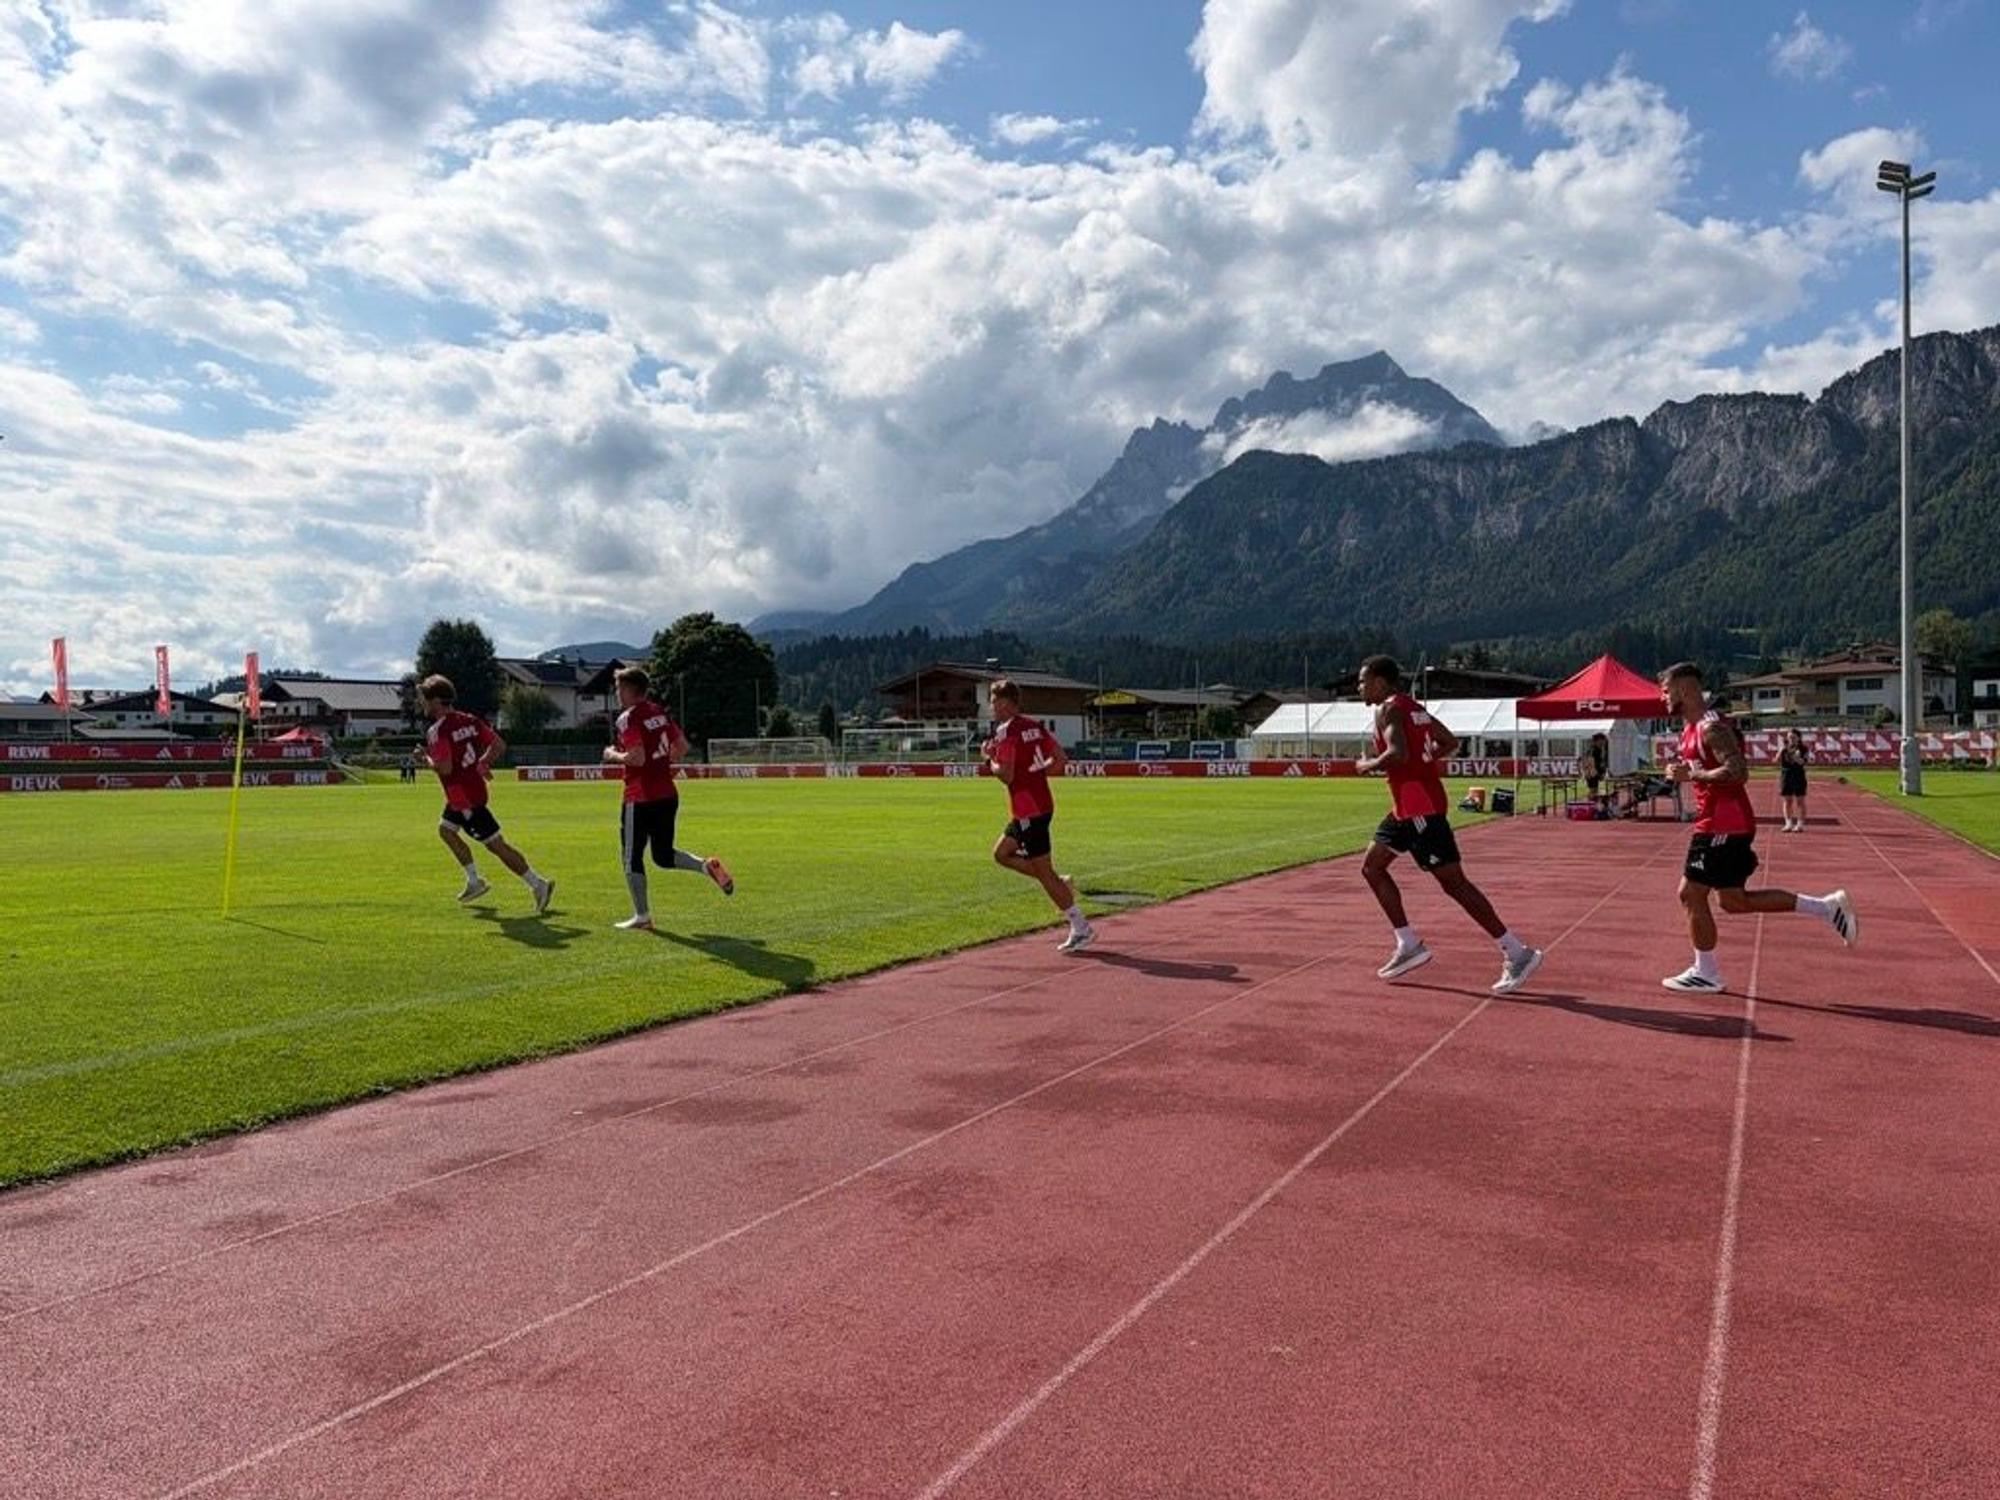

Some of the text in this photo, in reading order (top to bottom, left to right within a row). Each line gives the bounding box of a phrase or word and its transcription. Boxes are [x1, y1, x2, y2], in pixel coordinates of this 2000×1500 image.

[8, 746, 50, 759] REWE
[282, 746, 313, 758] REWE
[527, 767, 555, 779] REWE
[574, 767, 604, 779] DEVK
[943, 765, 979, 777] REWE
[1064, 763, 1106, 776] DEVK
[1207, 763, 1250, 776] REWE
[1447, 761, 1500, 775] DEVK
[1527, 761, 1579, 776] REWE
[11, 776, 61, 790] DEVK
